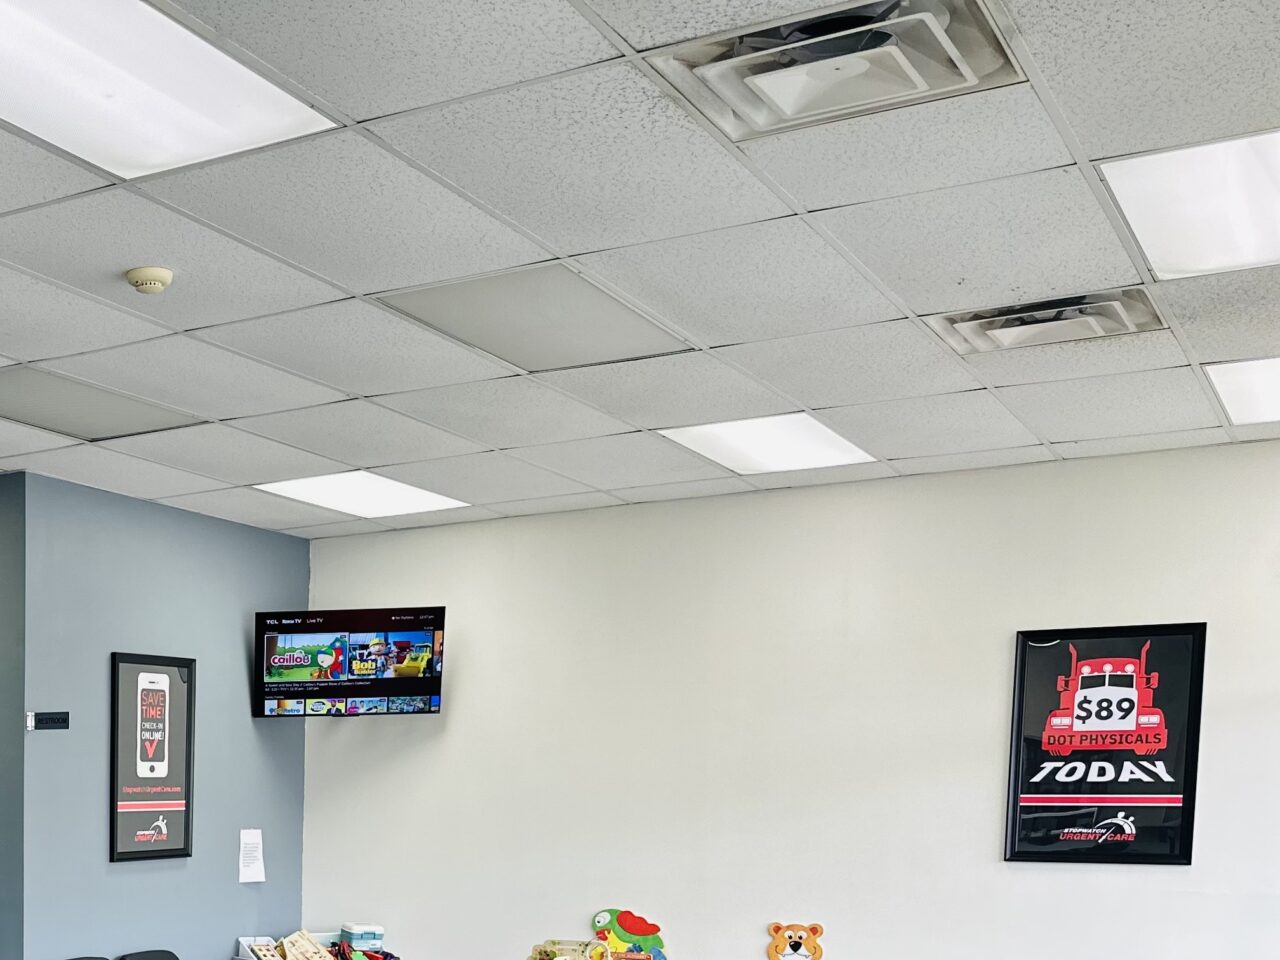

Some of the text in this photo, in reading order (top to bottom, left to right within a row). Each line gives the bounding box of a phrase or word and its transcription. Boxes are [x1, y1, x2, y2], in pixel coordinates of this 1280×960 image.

[352, 660, 376, 670] Bob
[142, 691, 165, 706] SAVE
[142, 706, 165, 719] TIME!
[1075, 695, 1135, 724] $89
[142, 731, 165, 740] ONLINE!
[1047, 733, 1162, 746] DOT PHYSICALS
[1029, 760, 1175, 782] TODAY
